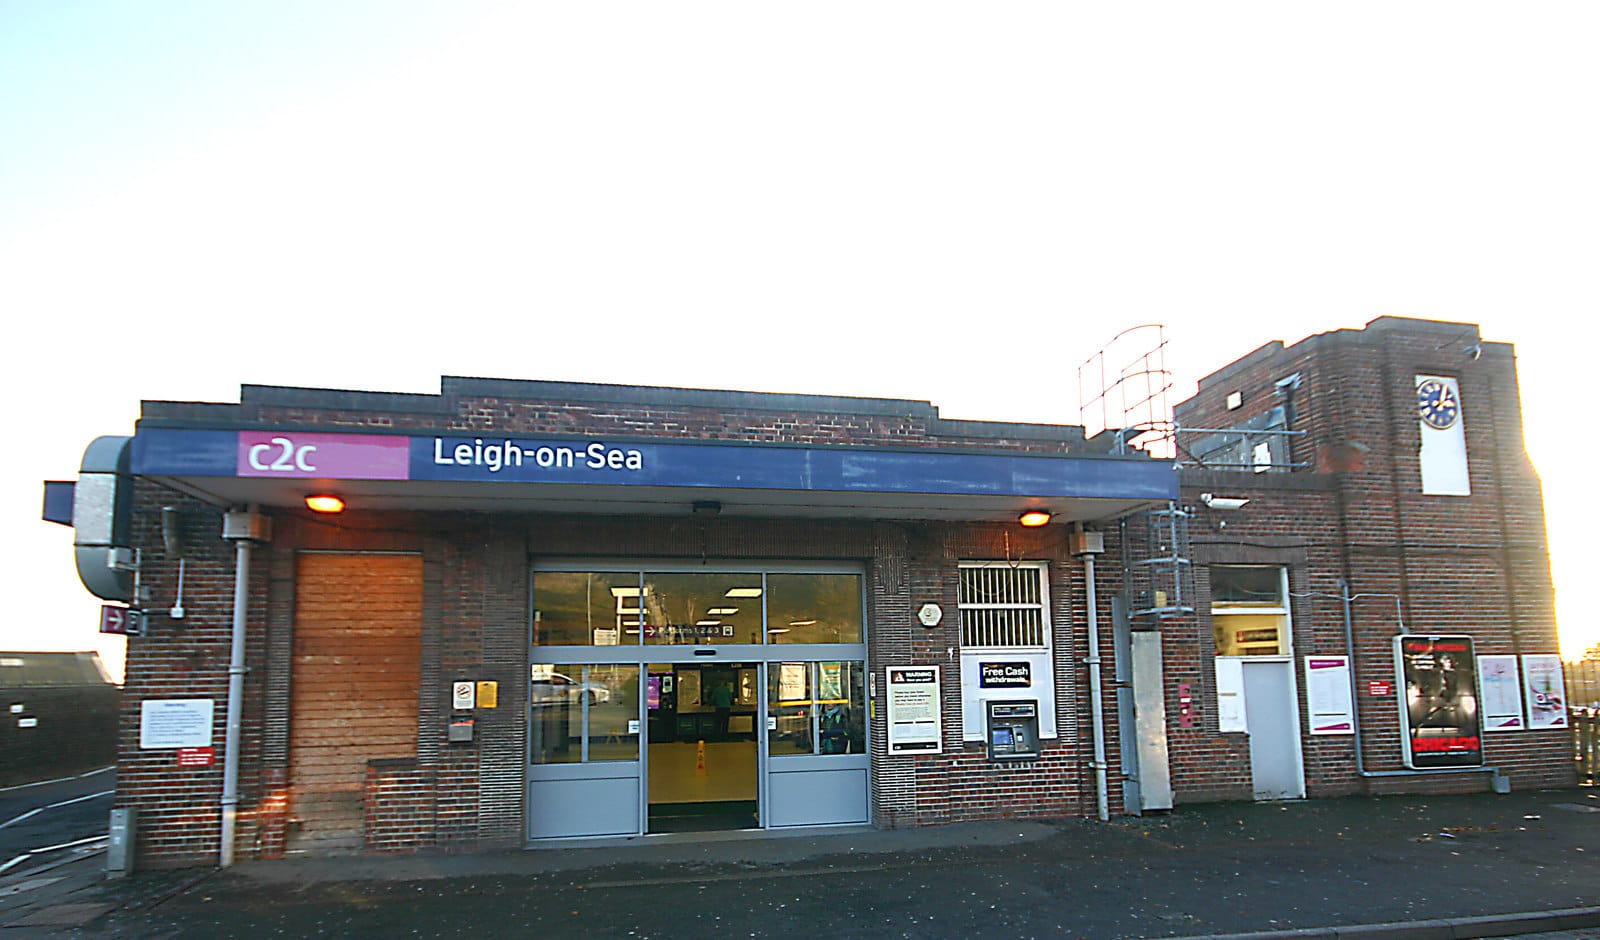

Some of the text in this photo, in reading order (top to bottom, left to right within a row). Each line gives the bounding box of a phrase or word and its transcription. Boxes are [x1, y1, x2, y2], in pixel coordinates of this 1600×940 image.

[249, 437, 317, 472] c2c
[434, 437, 642, 472] Leigh-on-Sea
[982, 666, 1028, 676] Free Cash
